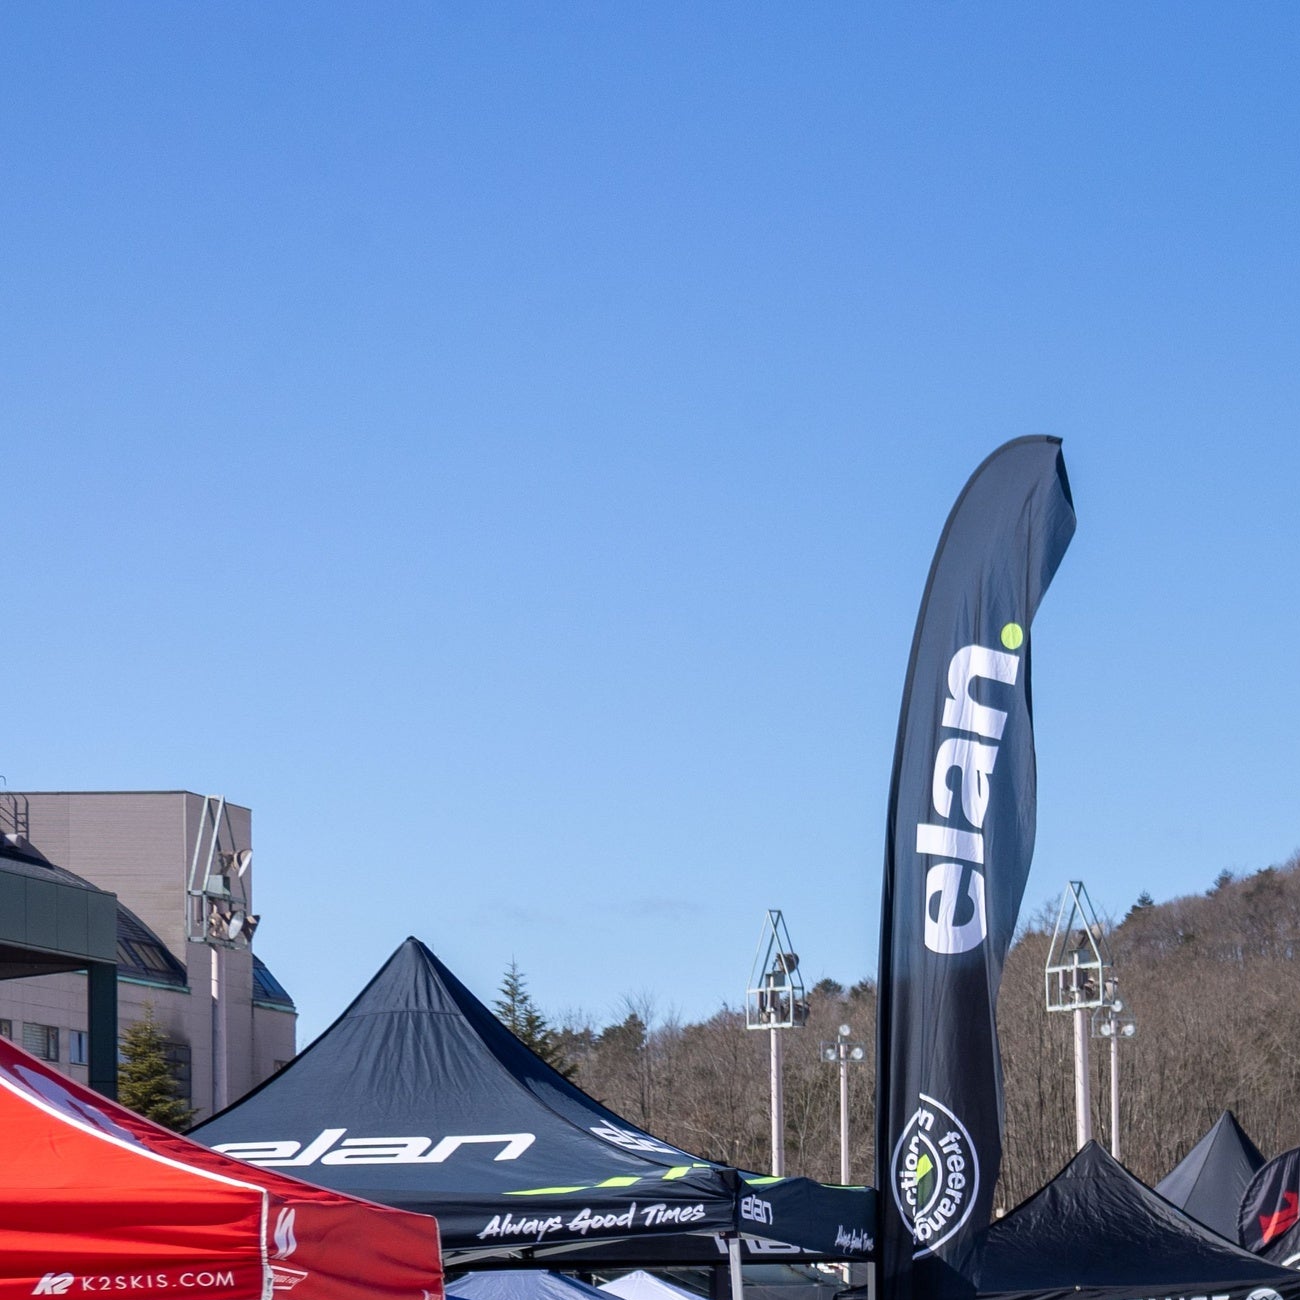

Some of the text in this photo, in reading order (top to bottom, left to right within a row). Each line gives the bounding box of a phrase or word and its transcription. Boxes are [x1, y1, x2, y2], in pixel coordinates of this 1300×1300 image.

[209, 1128, 536, 1166] elan
[477, 1202, 706, 1243] Always Good Times
[741, 1194, 773, 1226] elan
[31, 1270, 235, 1296] K2 K2SKIS.COM
